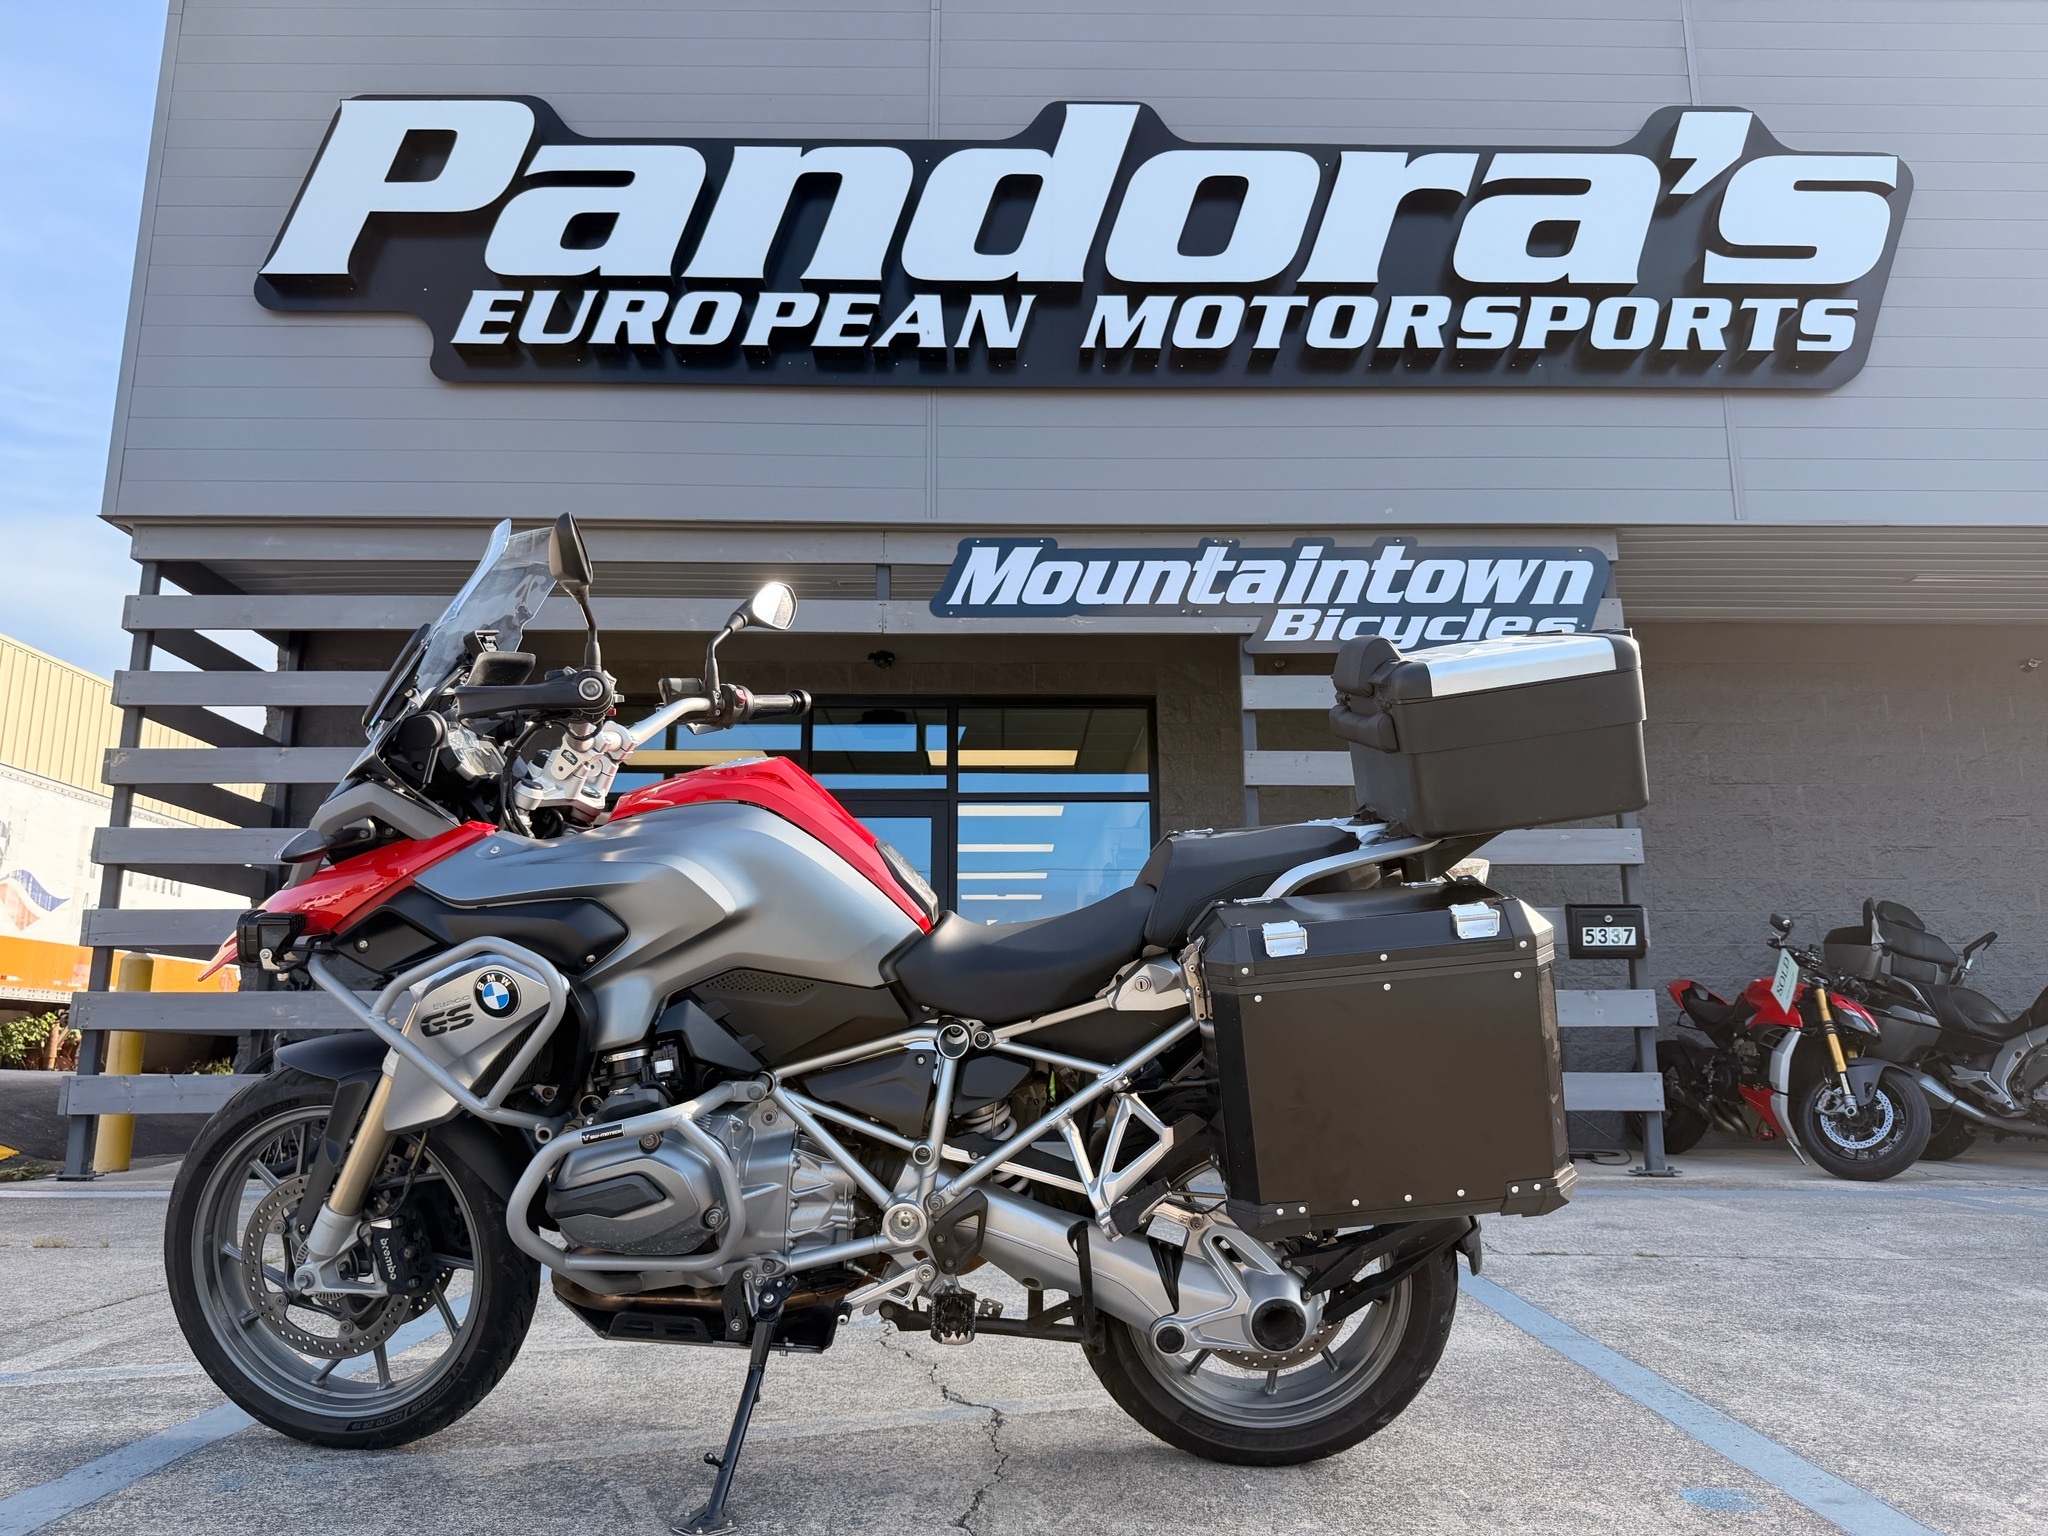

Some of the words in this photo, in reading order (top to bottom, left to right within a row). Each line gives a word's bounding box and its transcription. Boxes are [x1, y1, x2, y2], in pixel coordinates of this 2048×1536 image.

[258, 99, 1898, 285] Pandora's
[450, 289, 1037, 349] EUROPEAN
[1080, 294, 1859, 352] MOTORSPORTS
[945, 545, 1594, 606] Mountaintown
[1264, 608, 1579, 650] Bicycles
[1585, 928, 1633, 944] 5337
[1776, 956, 1790, 997] SOLD
[421, 1003, 475, 1038] GS
[380, 1237, 397, 1280] brembo
[410, 1374, 453, 1414] MICHELIN
